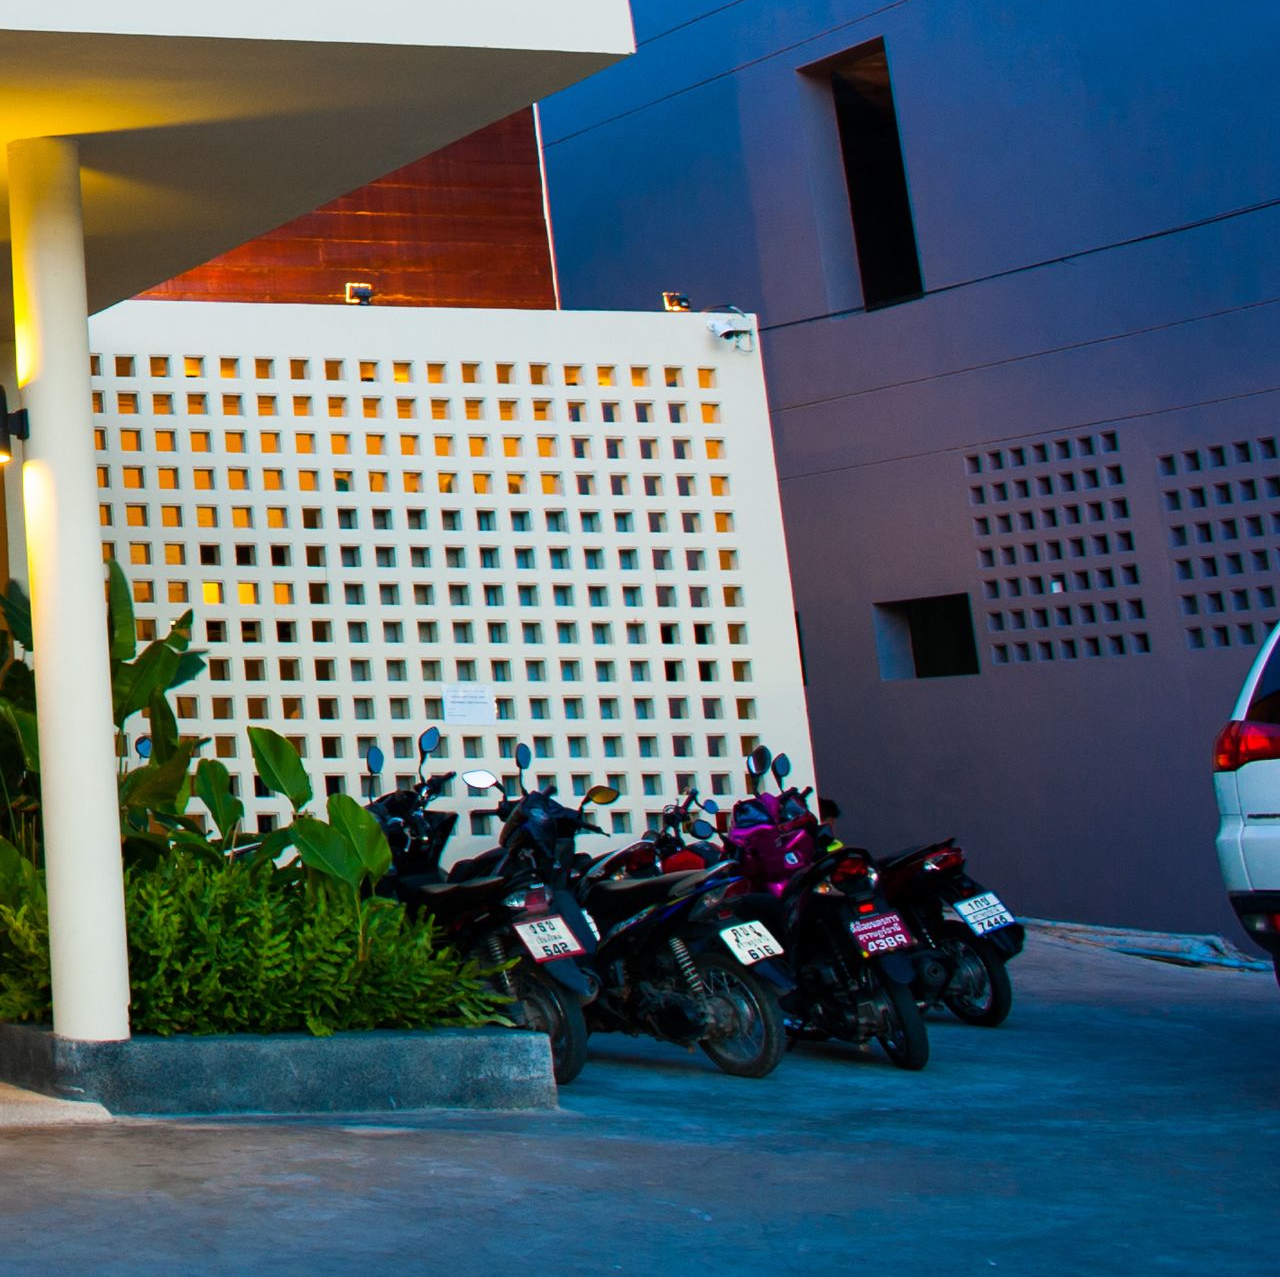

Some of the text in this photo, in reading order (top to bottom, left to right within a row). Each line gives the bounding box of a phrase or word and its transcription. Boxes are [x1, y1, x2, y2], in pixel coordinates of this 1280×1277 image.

[978, 915, 1008, 931] 7446
[542, 942, 571, 957] 542
[868, 934, 907, 952] 4389
